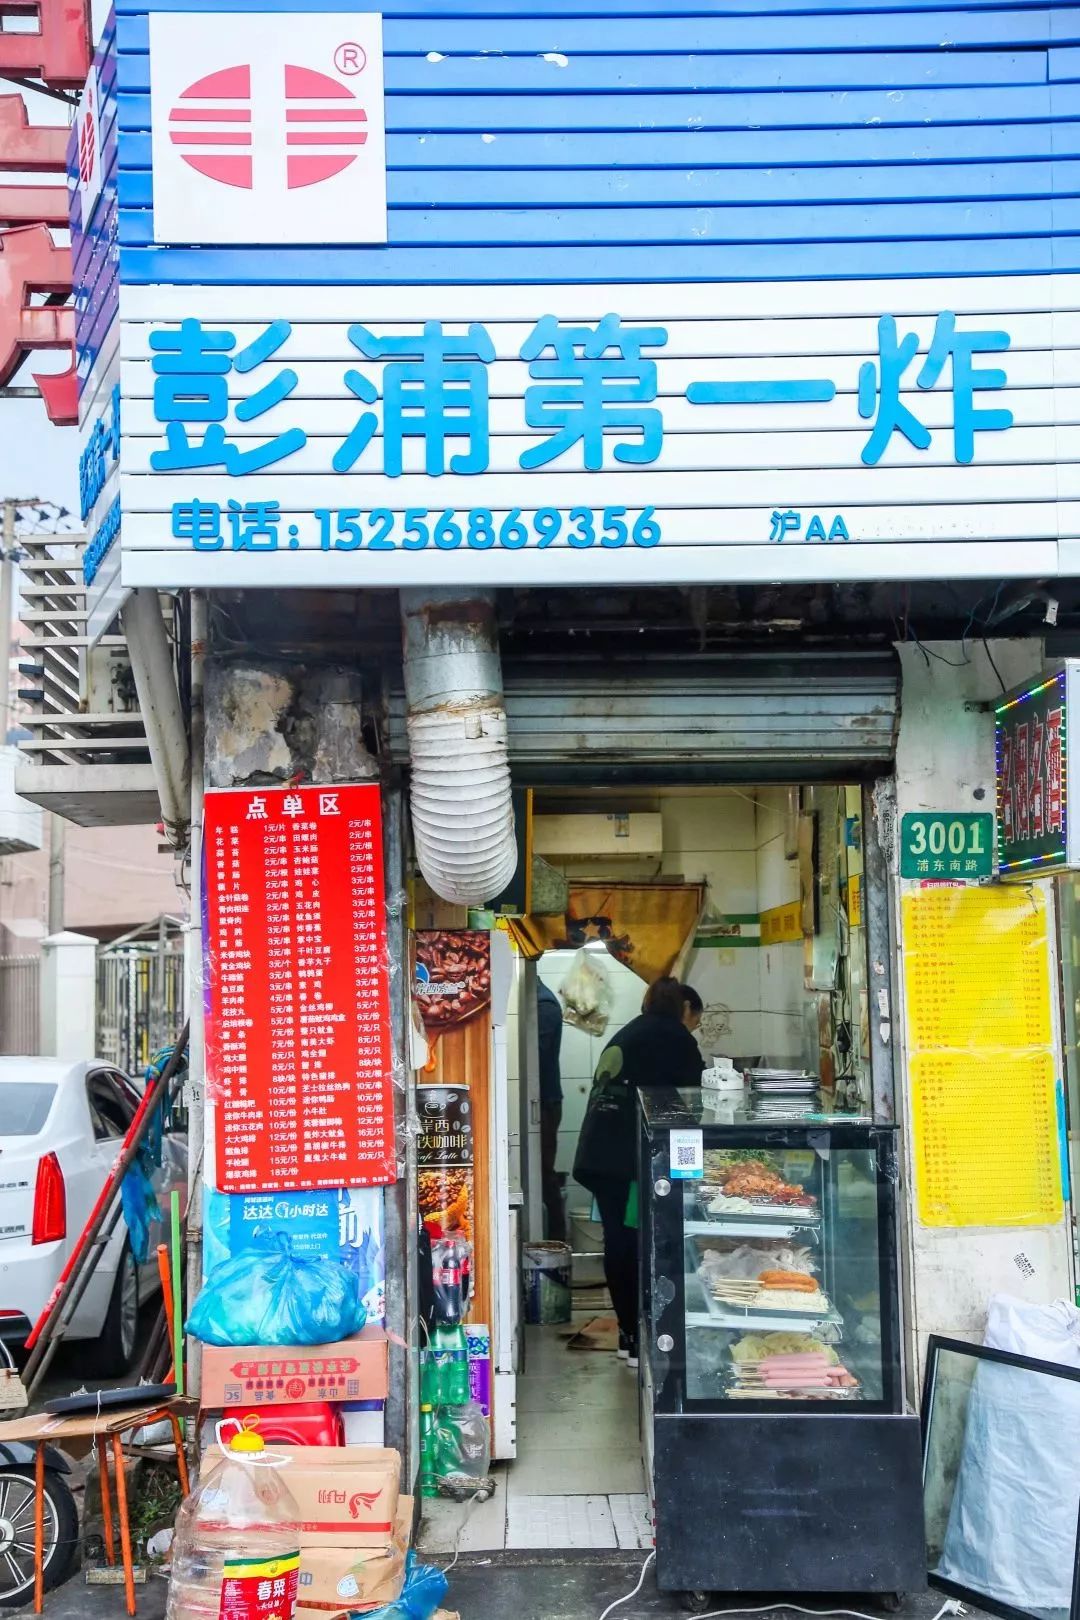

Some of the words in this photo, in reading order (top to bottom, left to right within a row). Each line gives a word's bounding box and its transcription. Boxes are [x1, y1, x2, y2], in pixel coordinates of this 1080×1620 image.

[149, 311, 1014, 478] 彭浦第一炸
[245, 793, 342, 820] 点单区
[265, 824, 285, 832] 1元/片
[264, 835, 286, 843] 2元/串
[910, 821, 985, 855] 3001
[264, 846, 287, 854] 2元/串
[350, 842, 372, 850] 2元/根
[916, 859, 978, 873] 浦东南路
[266, 869, 288, 877] 2元/根
[294, 867, 319, 875] 娃娃菜
[352, 876, 374, 884] 3元/串
[266, 891, 288, 899] 2元/串
[219, 905, 249, 913] 骨肉相连
[267, 903, 289, 911] 2元/串
[296, 901, 320, 909] 五花肉
[268, 914, 289, 922] 3元/串
[353, 910, 375, 918] 3元/串
[354, 921, 375, 929] 3元/个
[268, 937, 290, 945] 3元/串
[297, 935, 321, 943] 掌中宝
[269, 948, 291, 956] 3元/串
[298, 946, 330, 954] 千叶豆腐
[355, 944, 377, 952] 3元/串
[269, 960, 290, 968] 3元/个
[298, 957, 330, 966] 香芋丸子
[355, 955, 378, 963] 3元/串
[270, 971, 292, 979] 3元/串
[356, 978, 378, 986] 3元/串
[221, 985, 244, 993] 鱼豆腐
[270, 983, 292, 991] 3元/串
[222, 996, 244, 1004] 羊肉串
[271, 994, 292, 1002] 4元/串
[357, 1001, 379, 1009] 5元/个
[271, 1017, 293, 1025] 5元/串
[358, 1024, 380, 1032] 7元/只
[273, 1040, 294, 1048] 7元/份
[358, 1047, 381, 1055] 8元/只
[359, 1058, 382, 1066] 8块/块
[272, 1063, 295, 1071] 8元/只
[356, 1070, 382, 1078] 10元/根
[269, 1086, 296, 1094] 10元/根
[358, 1093, 382, 1101] 10元/份
[270, 1098, 296, 1106] 10元/份
[270, 1109, 296, 1117] 10元/份
[358, 1116, 383, 1124] 12元/份
[225, 1123, 263, 1132] 迷你五花肉
[270, 1121, 297, 1129] 10元/份
[358, 1128, 383, 1136] 16元/只
[226, 1134, 256, 1143] 大大鸡排
[270, 1132, 297, 1140] 12元/份
[271, 1144, 297, 1152] 13元/份
[359, 1140, 384, 1148] 18元/份
[358, 1151, 384, 1159] 20元/只
[271, 1156, 297, 1164] 15元/只
[271, 1168, 298, 1176] 18元/份
